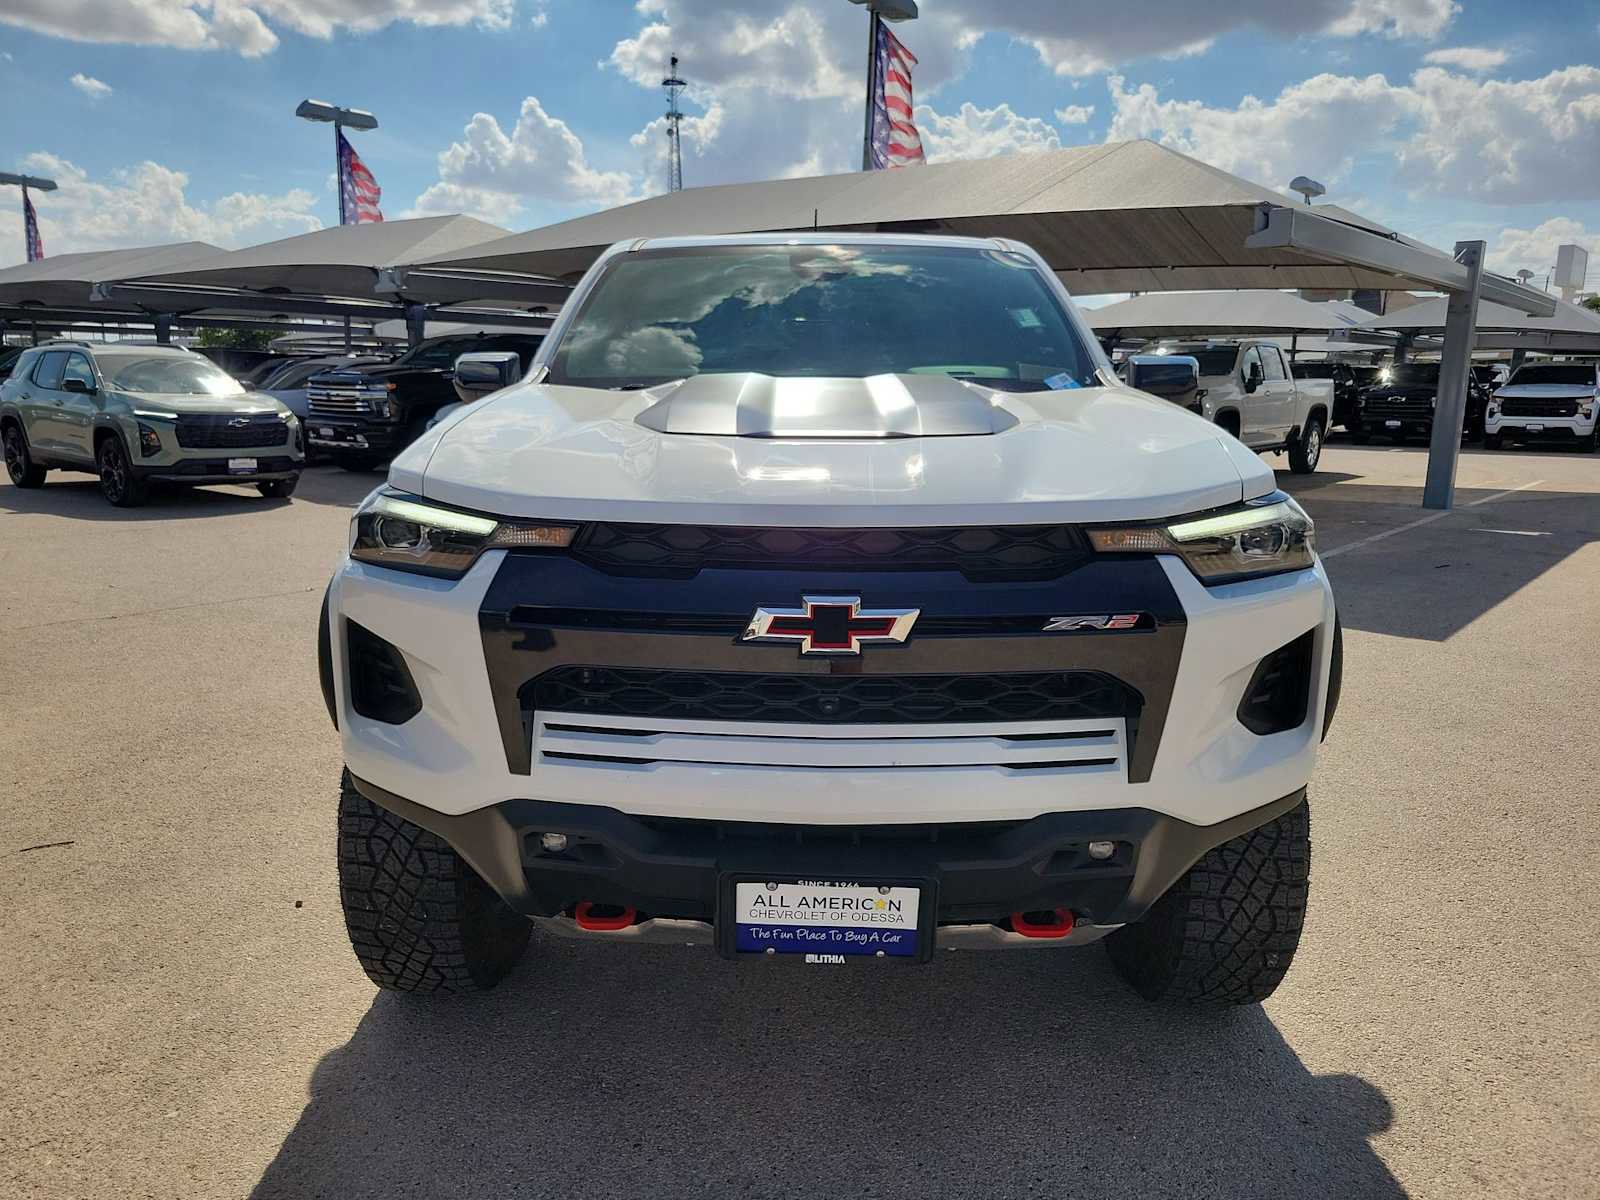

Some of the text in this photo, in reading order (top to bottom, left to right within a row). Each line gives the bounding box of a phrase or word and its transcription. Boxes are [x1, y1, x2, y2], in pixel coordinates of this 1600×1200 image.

[1041, 614, 1140, 631] ZR2
[753, 894, 790, 908] ALL
[749, 908, 904, 923] CHEVROLET OF ODESSA
[750, 927, 902, 945] The Fun Place To Buy A Car
[815, 953, 846, 964] LITHIA
